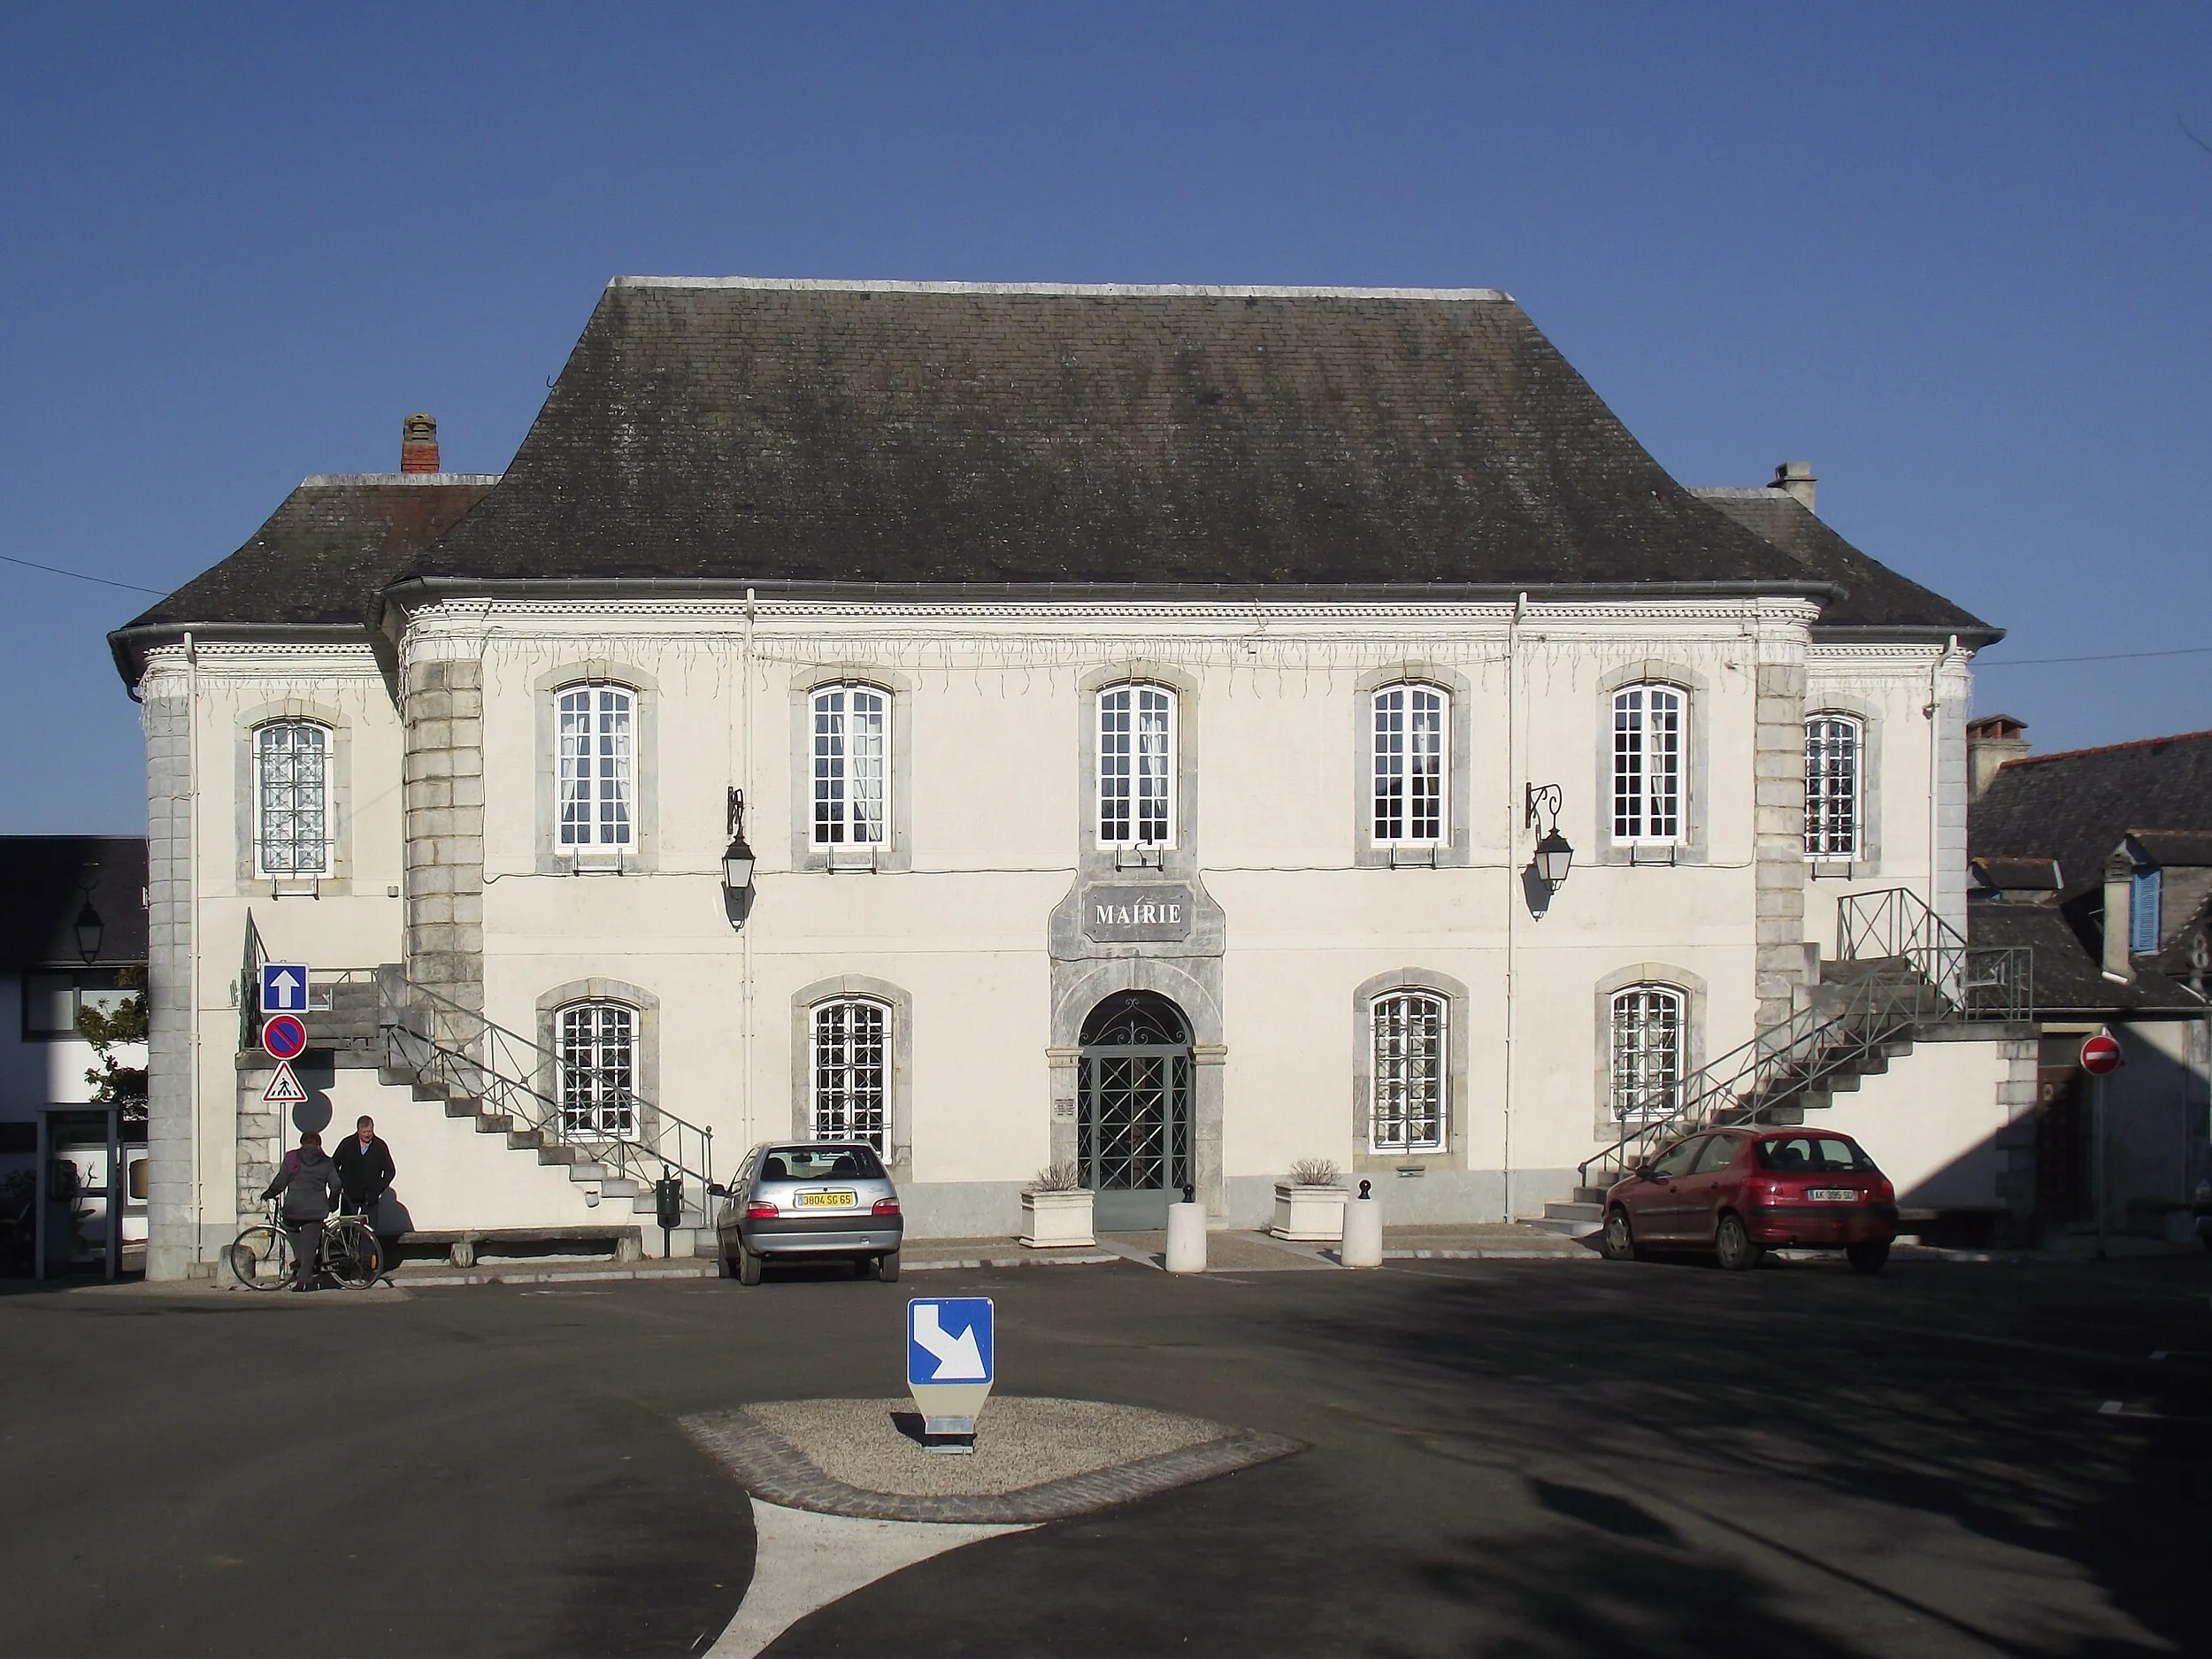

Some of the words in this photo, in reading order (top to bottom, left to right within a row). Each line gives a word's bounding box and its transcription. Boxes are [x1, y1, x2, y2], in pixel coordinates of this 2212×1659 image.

[1095, 903, 1182, 925] MAIRIE
[803, 1195, 825, 1205] 3804
[826, 1194, 838, 1204] SG
[840, 1194, 851, 1204] 65
